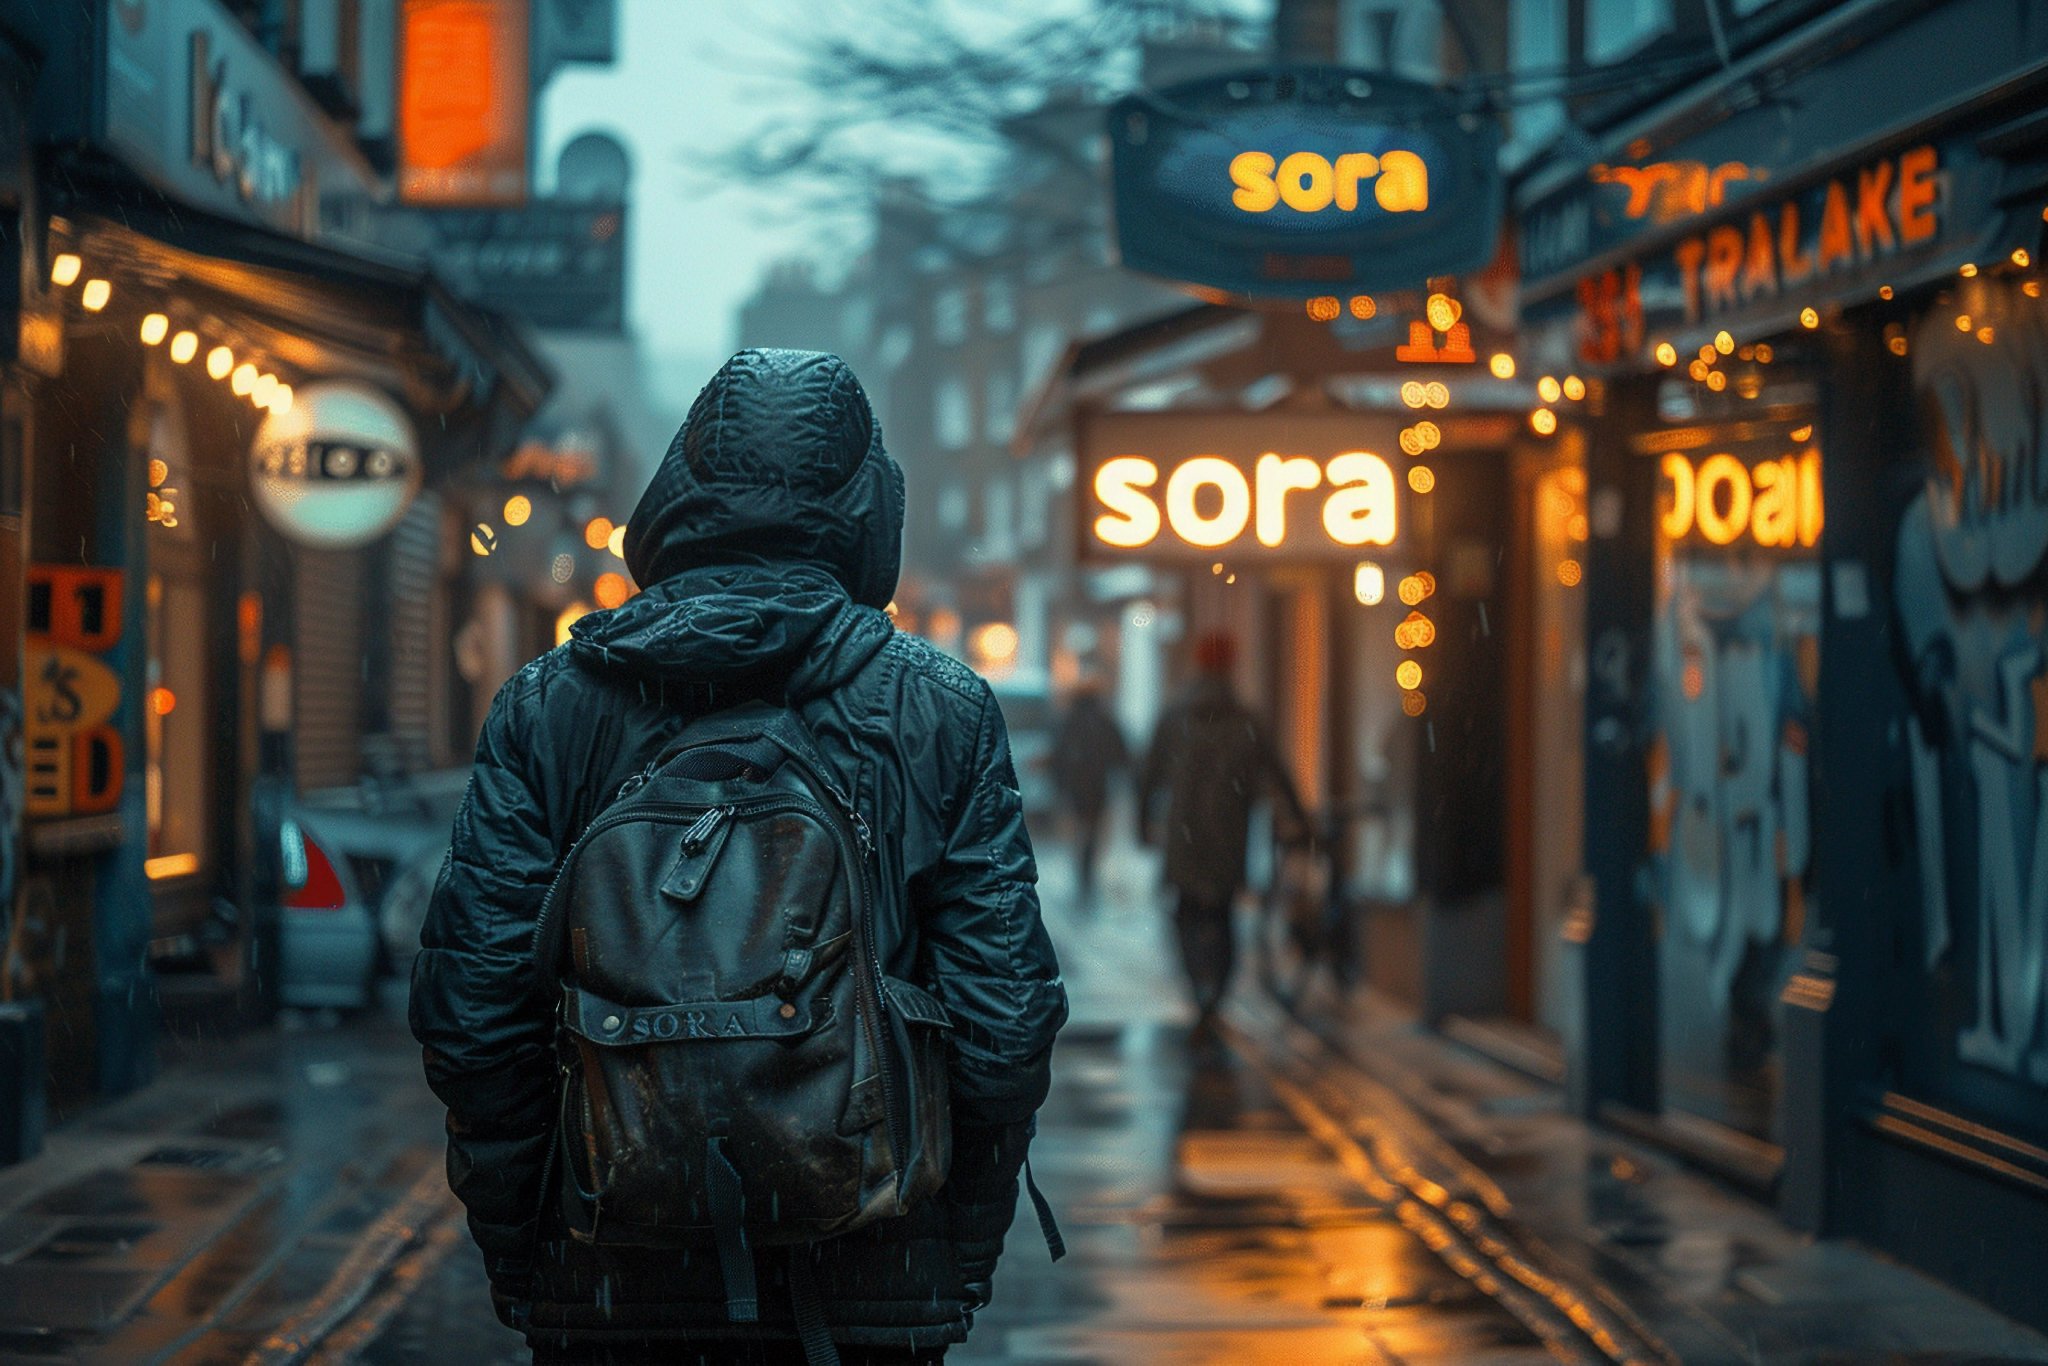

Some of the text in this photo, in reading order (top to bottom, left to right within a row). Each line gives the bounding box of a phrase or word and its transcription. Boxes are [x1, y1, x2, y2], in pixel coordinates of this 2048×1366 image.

[1229, 150, 1428, 212] sora
[1094, 451, 1397, 547] sora
[632, 1011, 748, 1039] SORA
